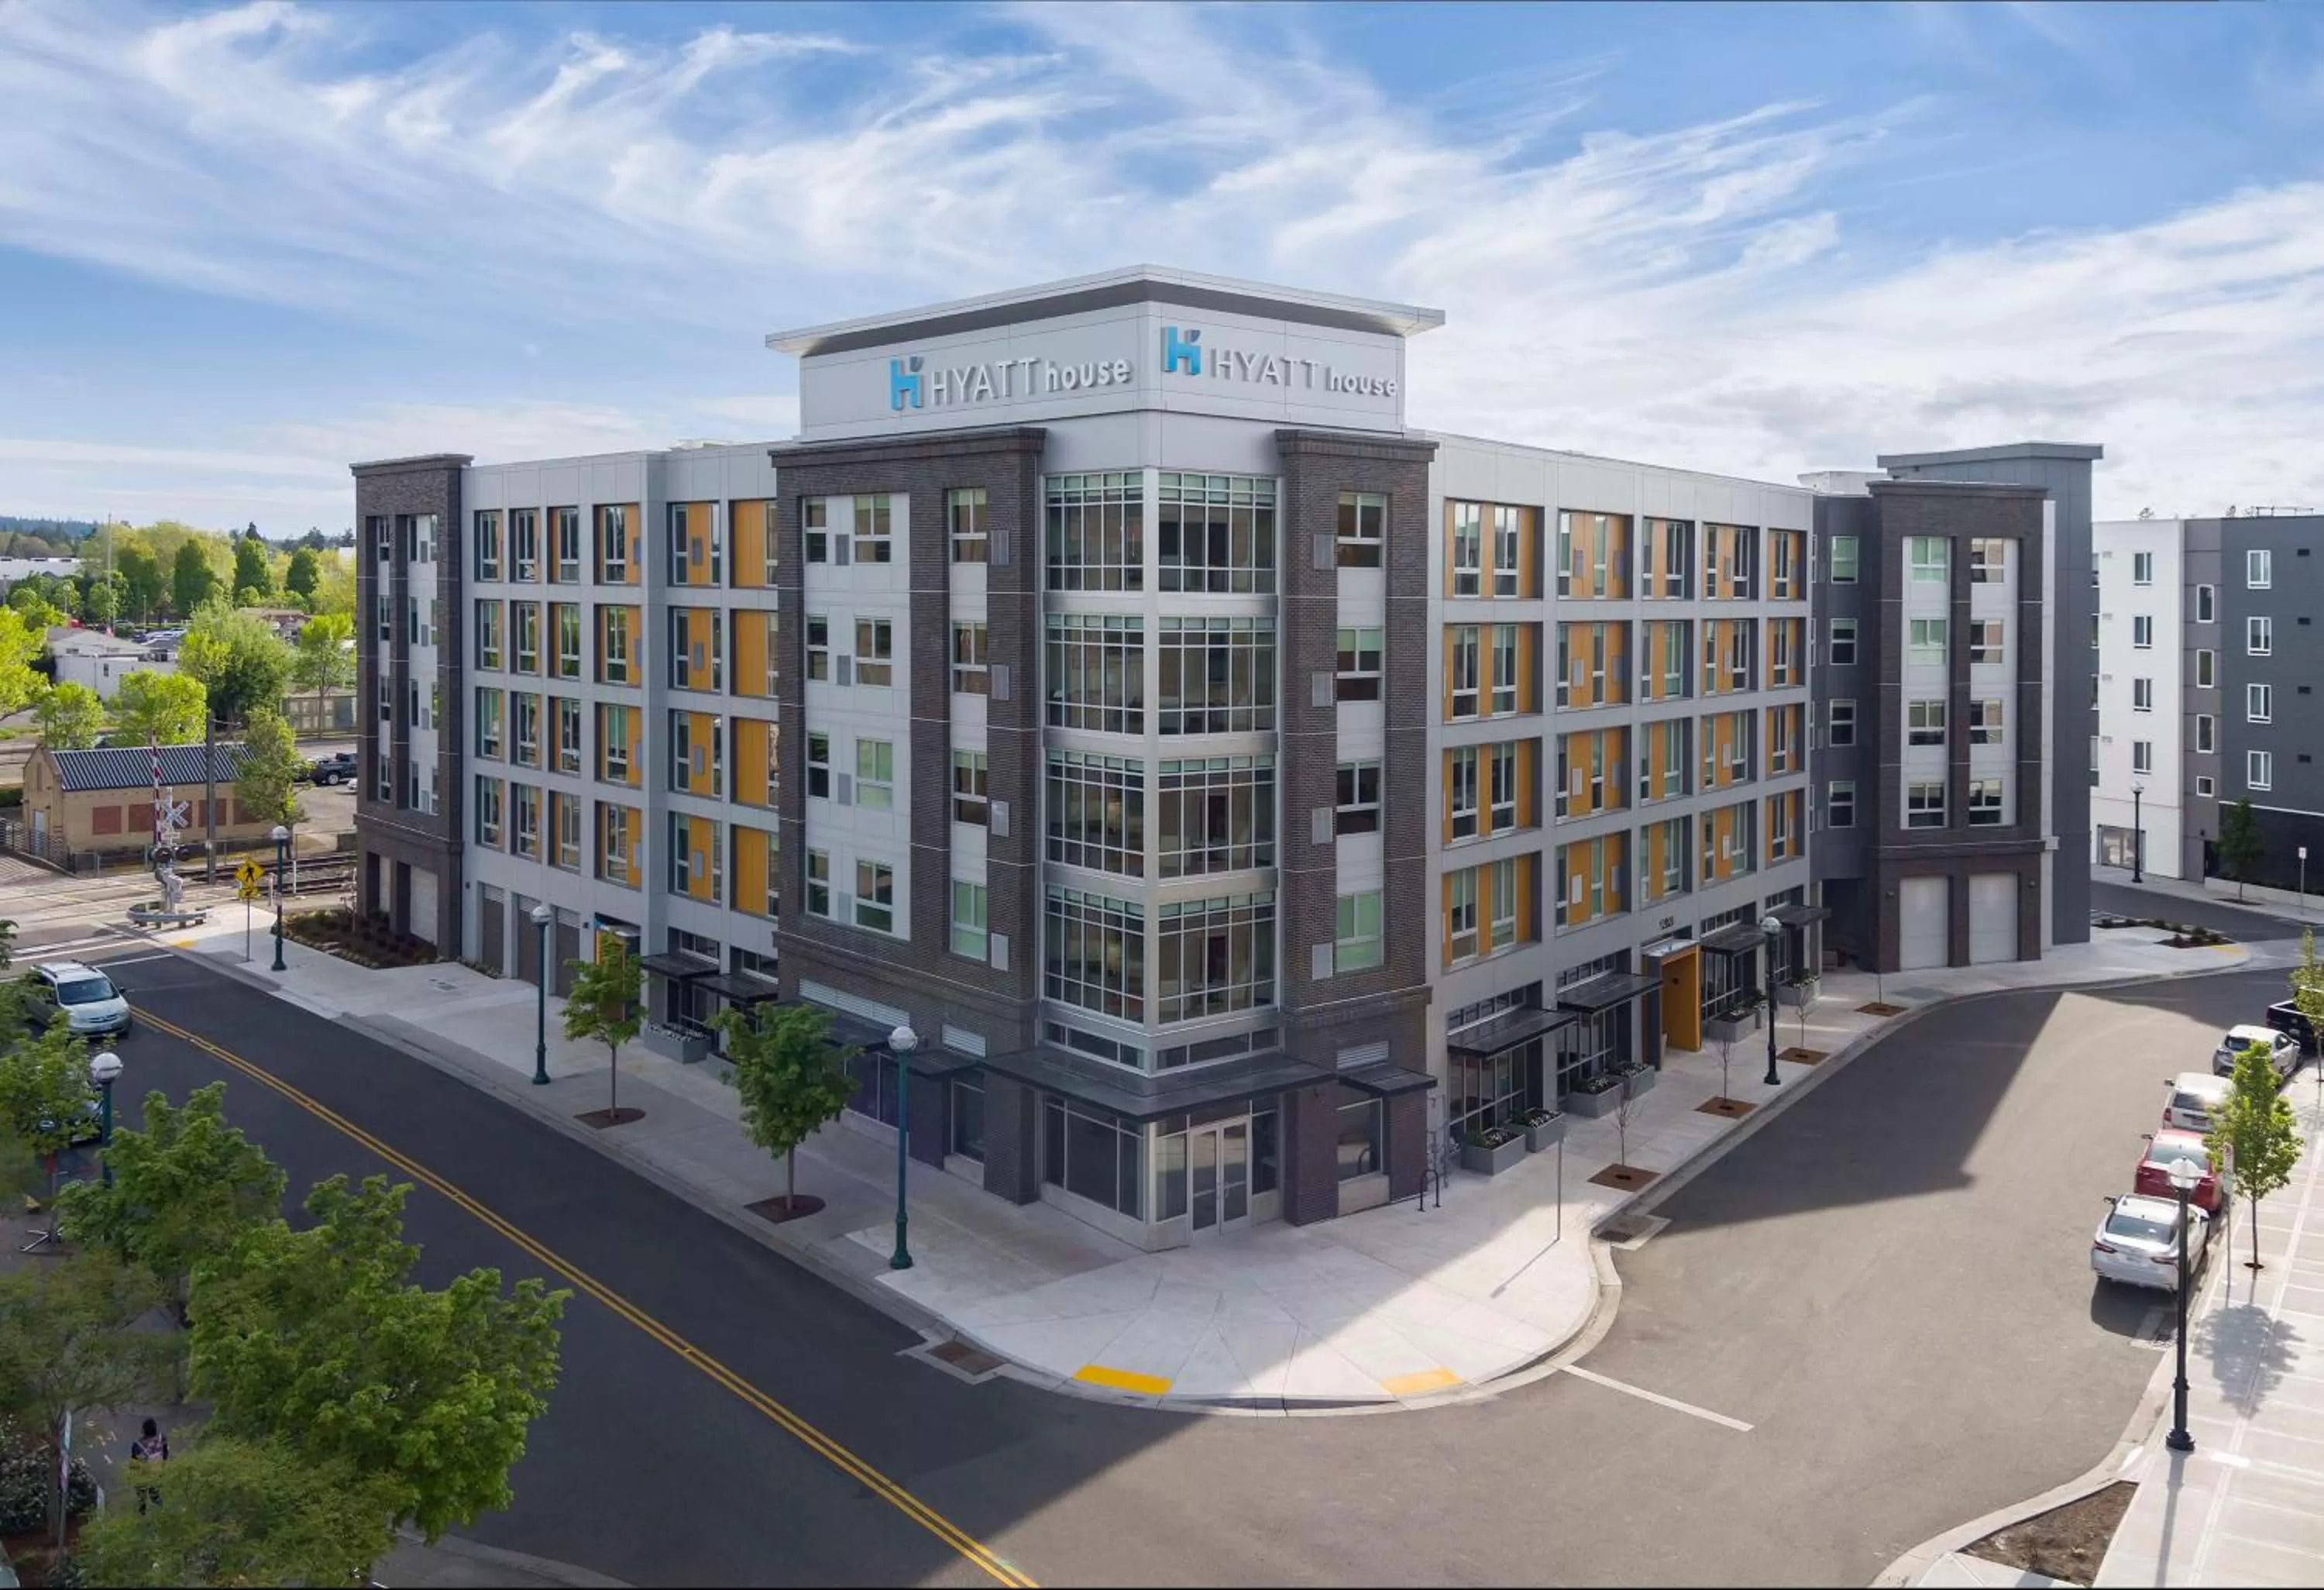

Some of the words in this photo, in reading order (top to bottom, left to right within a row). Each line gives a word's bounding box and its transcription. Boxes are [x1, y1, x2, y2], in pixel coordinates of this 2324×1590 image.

[931, 357, 1040, 405] HYATT
[1046, 358, 1132, 392] house
[1212, 349, 1322, 388] HYATT
[1328, 366, 1398, 397] house
